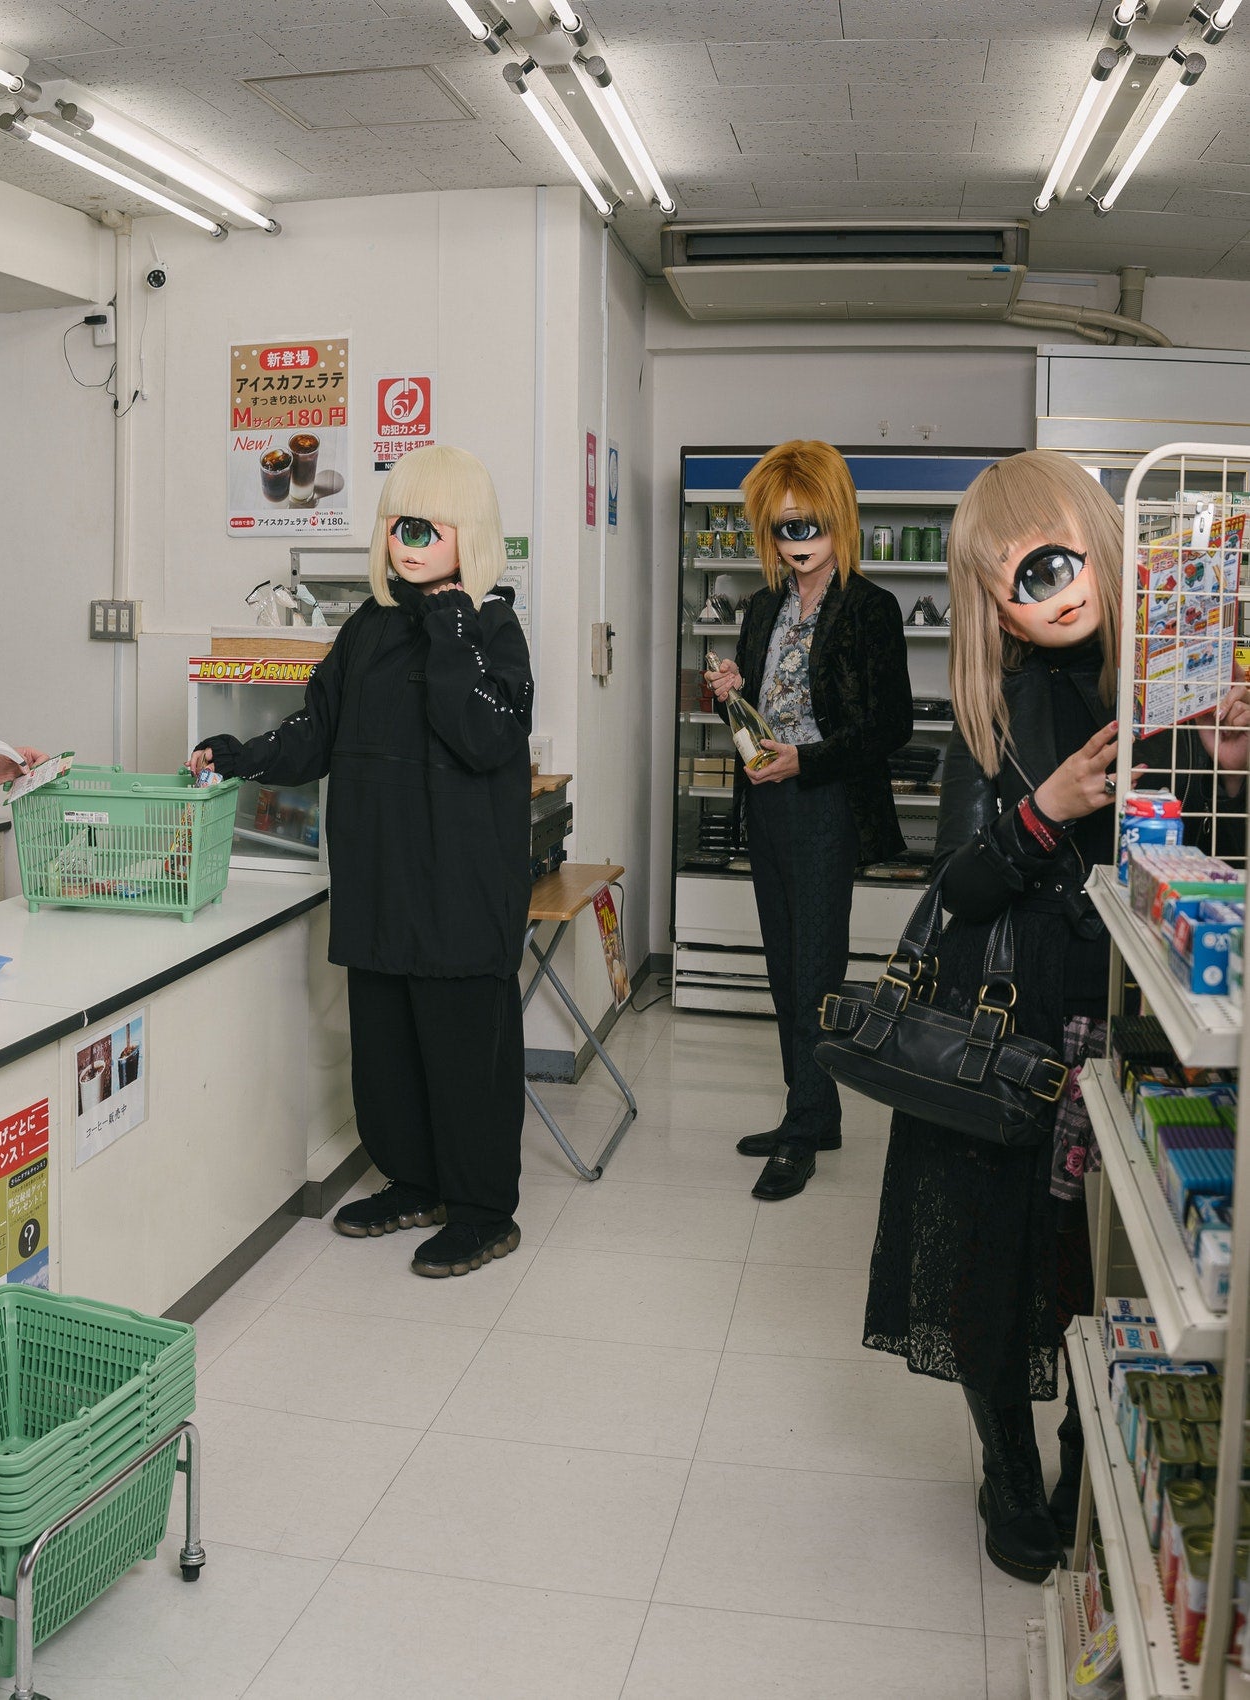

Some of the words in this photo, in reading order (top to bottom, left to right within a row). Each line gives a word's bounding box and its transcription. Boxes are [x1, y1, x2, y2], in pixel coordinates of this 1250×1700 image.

[267, 350, 310, 368] 新登場
[236, 372, 344, 393] アイスカフェラテ
[251, 394, 326, 406] すっきりおいしい
[381, 424, 426, 436] 防犯カメラ
[233, 435, 273, 451] New!
[257, 518, 308, 527] アイスカフェラテ
[199, 661, 246, 679] HOT!
[86, 1103, 127, 1139] コーヒー販売中
